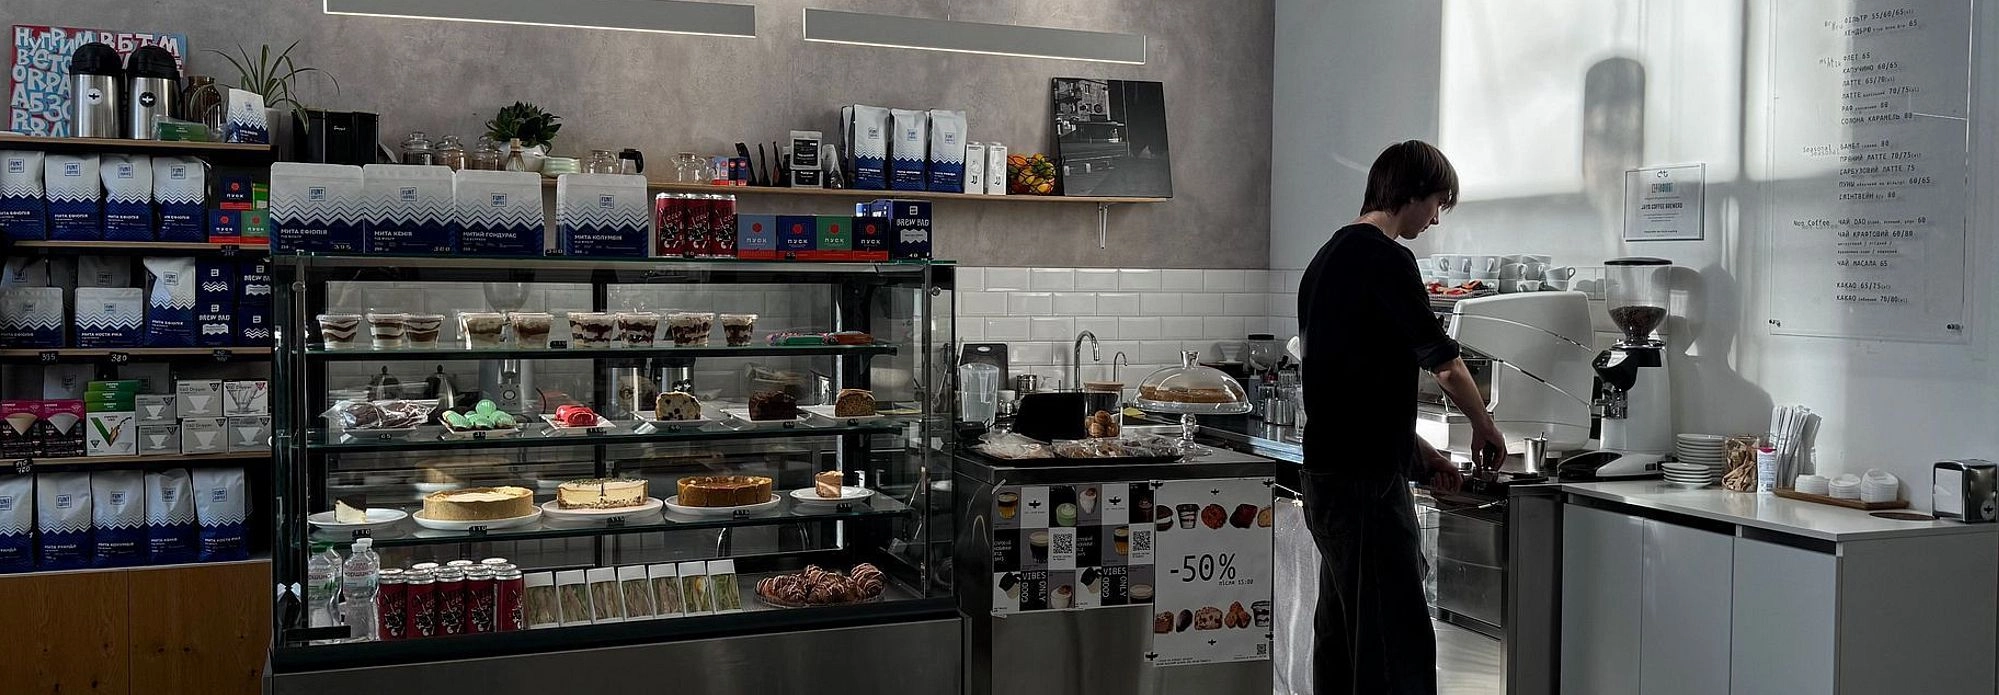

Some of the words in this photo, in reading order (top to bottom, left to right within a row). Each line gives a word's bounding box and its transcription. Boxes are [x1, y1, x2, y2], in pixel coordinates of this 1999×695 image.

[1908, 19, 1918, 28] 65
[1862, 52, 1871, 60] 65
[1842, 79, 1862, 88] ЛАТТЕ
[1841, 92, 1862, 100] ЛАТТЕ
[1868, 114, 1901, 123] КАРАМЕЛЬ
[1866, 153, 1887, 161] ЛАТТЕ
[1882, 164, 1903, 173] ЛАТТЕ
[896, 217, 916, 227] BREW
[916, 218, 931, 227] BAG
[1807, 218, 1830, 227] Coffee
[1838, 218, 1850, 226] ЧАЙ
[1837, 229, 1850, 238] ЧАЙ
[1837, 258, 1850, 267] ЧАЙ
[1852, 259, 1877, 268] МАСАЛА
[1879, 259, 1888, 268] 65
[1836, 281, 1857, 290] КАКАО
[1836, 294, 1857, 303] КАКАО
[111, 353, 129, 363] 380
[1103, 566, 1128, 576] VIBES
[1170, 553, 1236, 582] -50%
[1021, 570, 1047, 580] VIBES
[1101, 576, 1111, 599] GOOD
[1118, 576, 1128, 597] ONLY
[1020, 582, 1030, 604] GOOD
[1037, 580, 1048, 603] ONLY
